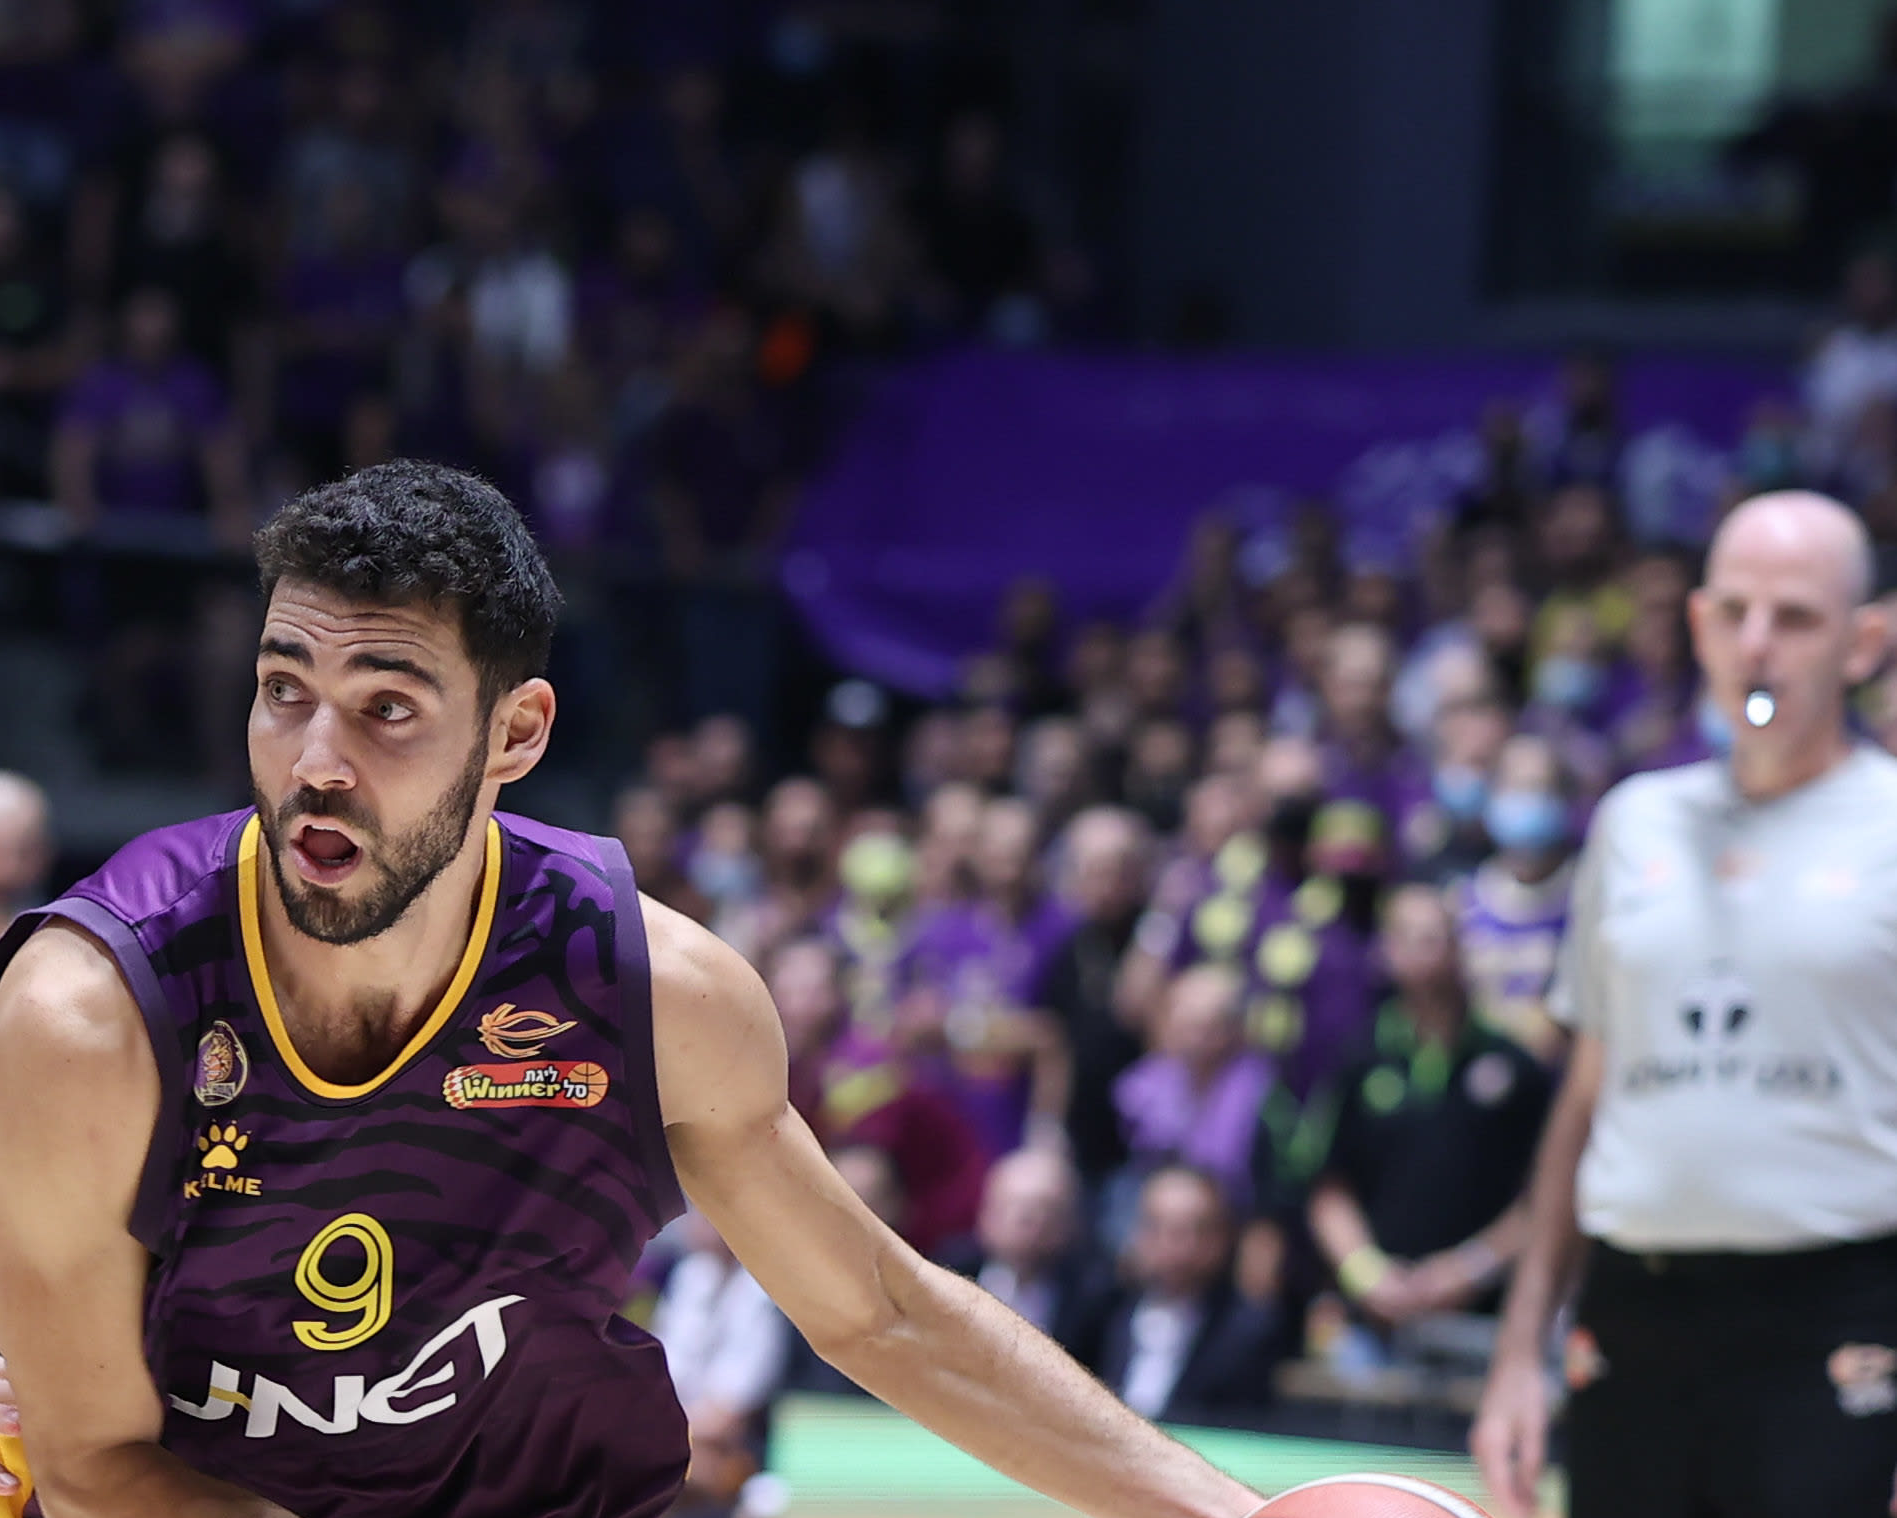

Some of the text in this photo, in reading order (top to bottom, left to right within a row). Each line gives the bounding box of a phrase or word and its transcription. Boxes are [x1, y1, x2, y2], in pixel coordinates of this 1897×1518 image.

[524, 1066, 558, 1082] ליגת
[463, 1076, 588, 1099] Winner סל
[293, 1213, 393, 1351] 9
